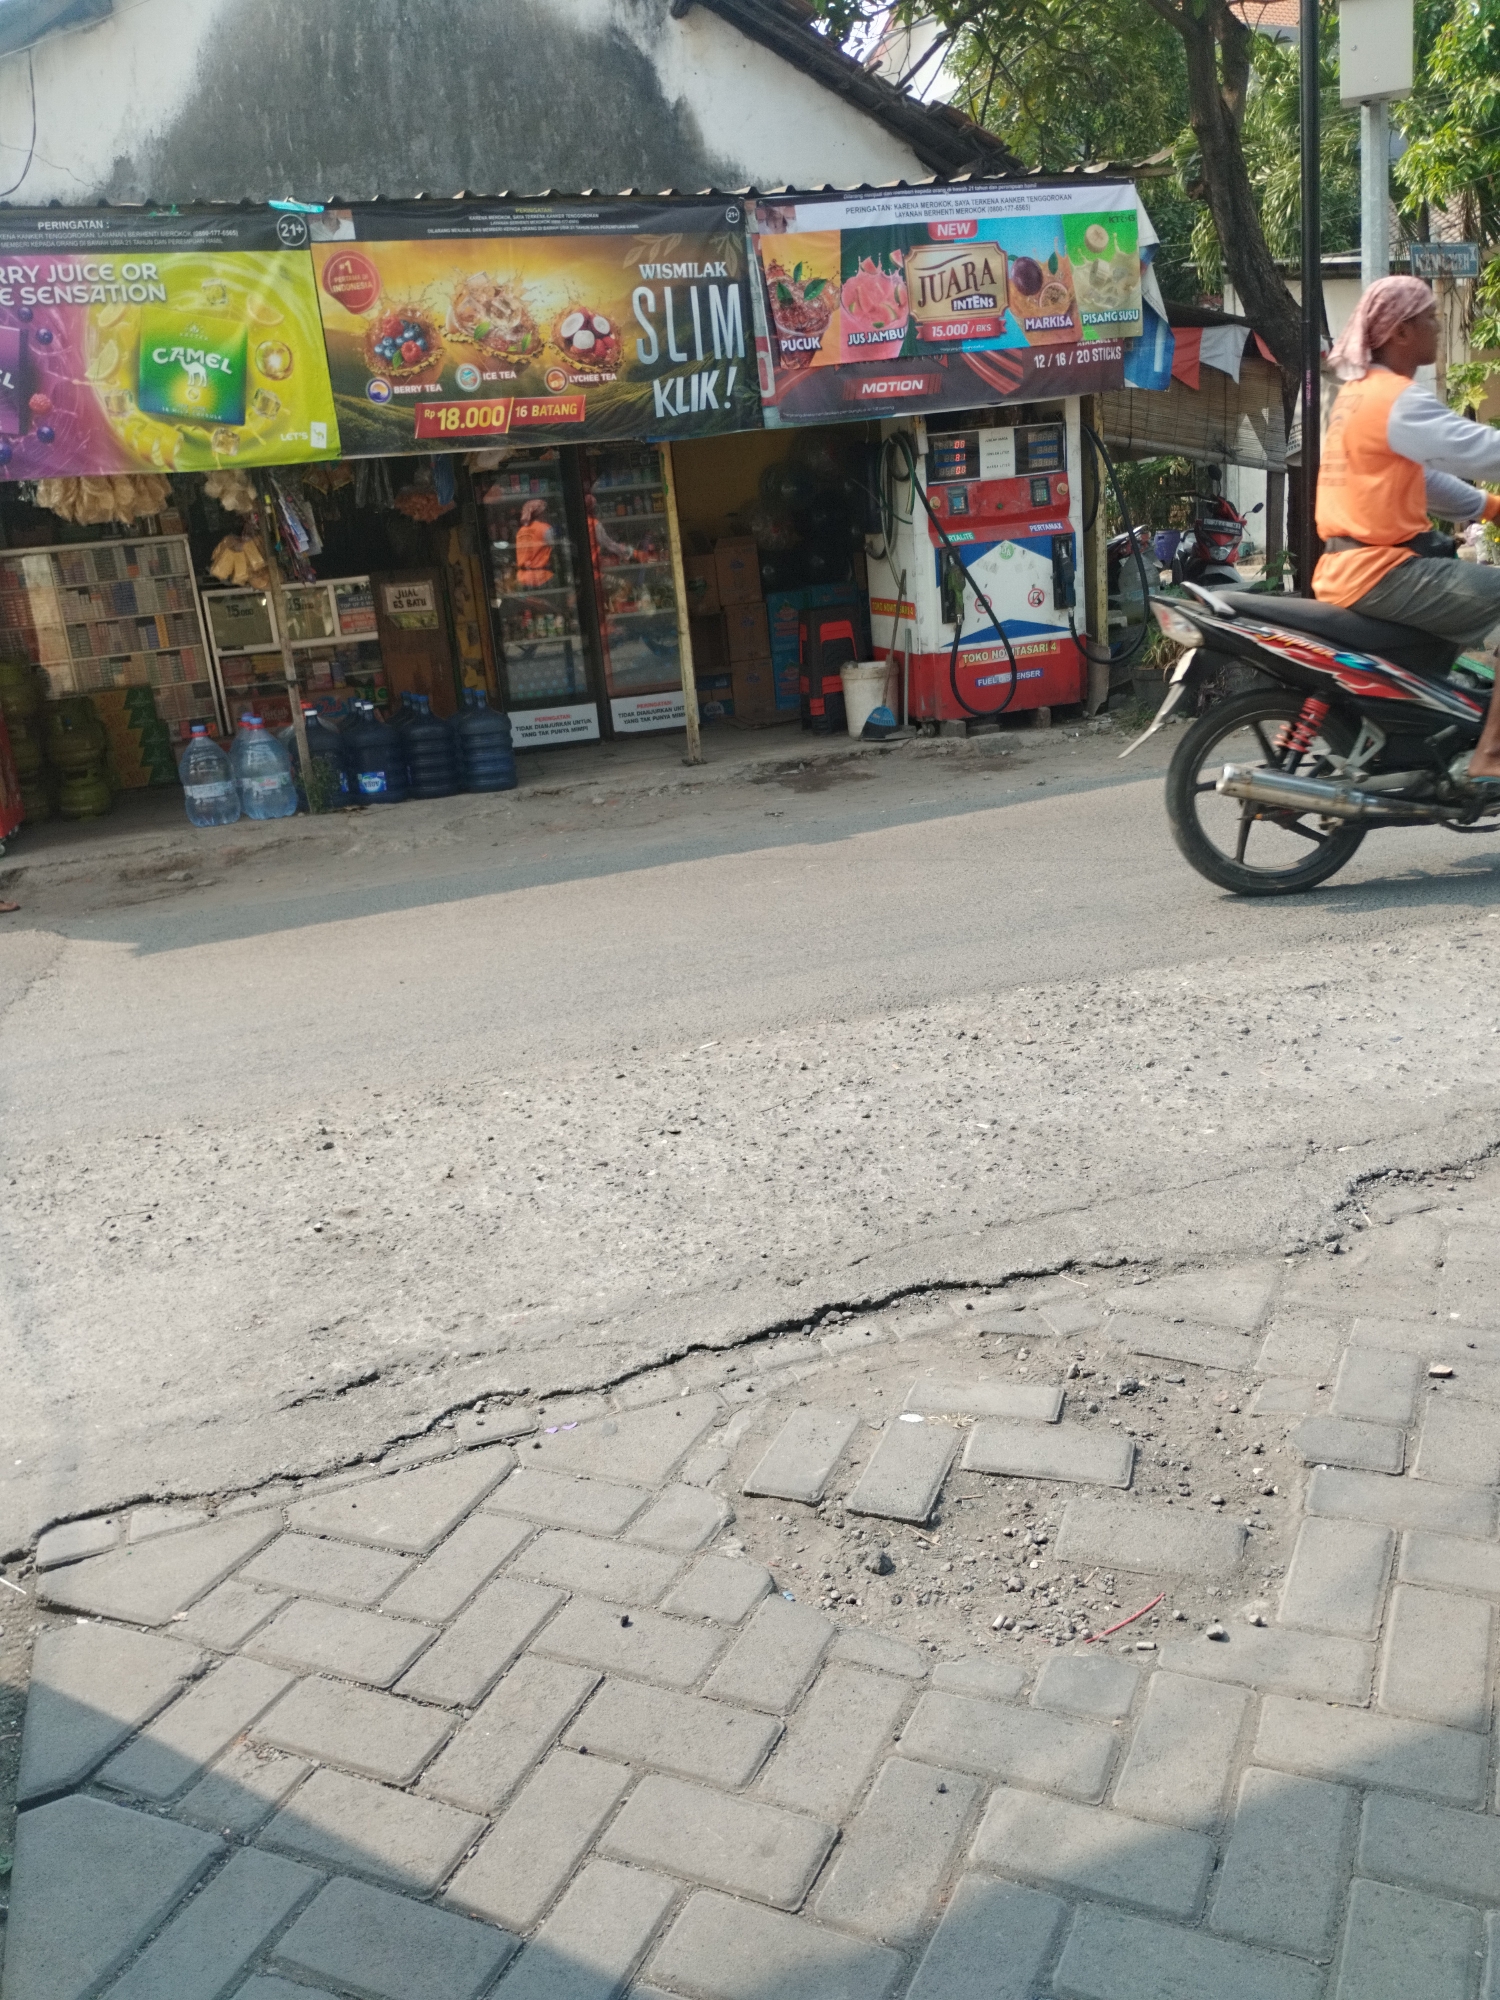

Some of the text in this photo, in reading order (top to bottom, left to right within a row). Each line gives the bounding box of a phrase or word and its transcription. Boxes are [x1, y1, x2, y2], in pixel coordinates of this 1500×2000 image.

[845, 204, 892, 215] PERINGATAN:
[894, 202, 919, 210] KARENA
[971, 198, 999, 206] TERKENA
[1001, 196, 1025, 204] KANKER
[1026, 194, 1072, 203] TENGGOROKAN
[895, 210, 922, 218] LAYANAN
[924, 209, 955, 217] BERHENTI
[956, 207, 987, 215] MEROKOK
[38, 221, 103, 230] PERINGATAN
[281, 223, 304, 238] 21+
[937, 223, 970, 237] NEW
[17, 232, 44, 240] KANKER
[47, 263, 115, 284] JUICE
[121, 263, 158, 282] OR
[639, 261, 728, 279] WISMILAK
[332, 281, 373, 293] INDONESIA
[918, 257, 997, 308] JUARA
[20, 284, 167, 306] SENSATION
[632, 283, 745, 365] SLIM
[1025, 315, 1073, 330] MARKISA
[1082, 311, 1139, 324] PISANG SUSU
[976, 323, 991, 332] BKS
[848, 327, 904, 345] JUS JAMBU
[781, 337, 821, 351] PUCUK
[152, 347, 233, 375] CAMEL
[1034, 354, 1046, 368] 12
[1055, 352, 1066, 366] 16
[1077, 350, 1090, 364] 20
[1092, 346, 1122, 361] STICKS
[482, 371, 517, 382] ICE TEA
[568, 373, 618, 384] LYCHEE TEA
[393, 383, 443, 395] BERRY TEA
[653, 366, 737, 418] KLIK!
[861, 379, 923, 395] MOTION
[424, 403, 577, 431] Rp 18.000 16 BATANG
[280, 431, 309, 442] LET'S
[1029, 522, 1063, 532] PERTAMAX
[395, 588, 419, 600] JUAL
[393, 598, 427, 609] ES BATU
[962, 651, 988, 664] TOKO
[1050, 642, 1057, 651] 4
[978, 670, 1041, 686] FUEL DISENSER
[636, 707, 672, 717] DIANJURKAN
[653, 714, 671, 722] PUNYA
[534, 720, 572, 730] DIANJURKAN
[573, 718, 592, 726] UNTUK
